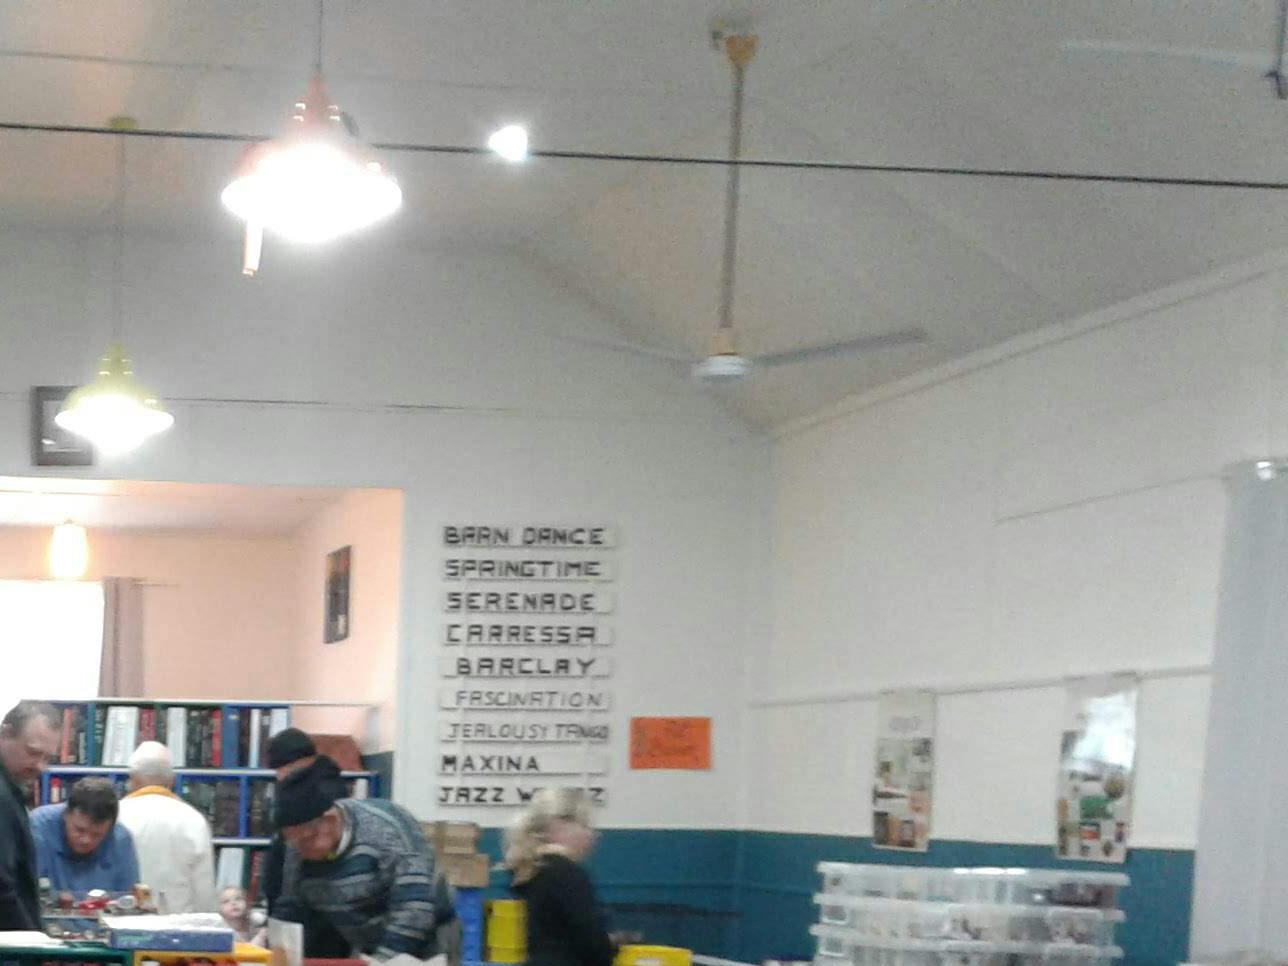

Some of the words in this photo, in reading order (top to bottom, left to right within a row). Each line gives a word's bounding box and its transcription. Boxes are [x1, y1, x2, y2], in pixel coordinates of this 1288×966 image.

[443, 526, 509, 545] BARN
[522, 527, 605, 545] DANCE
[444, 559, 601, 578] SPRINGTIME
[446, 592, 595, 611] SERENADE
[447, 624, 596, 644] CARRESSA
[457, 657, 596, 676] BARCLAY
[456, 691, 603, 709] FASCINATION
[448, 723, 548, 740] JEALOUSY
[442, 755, 540, 772] MAXINA
[439, 787, 505, 803] JAZZ
